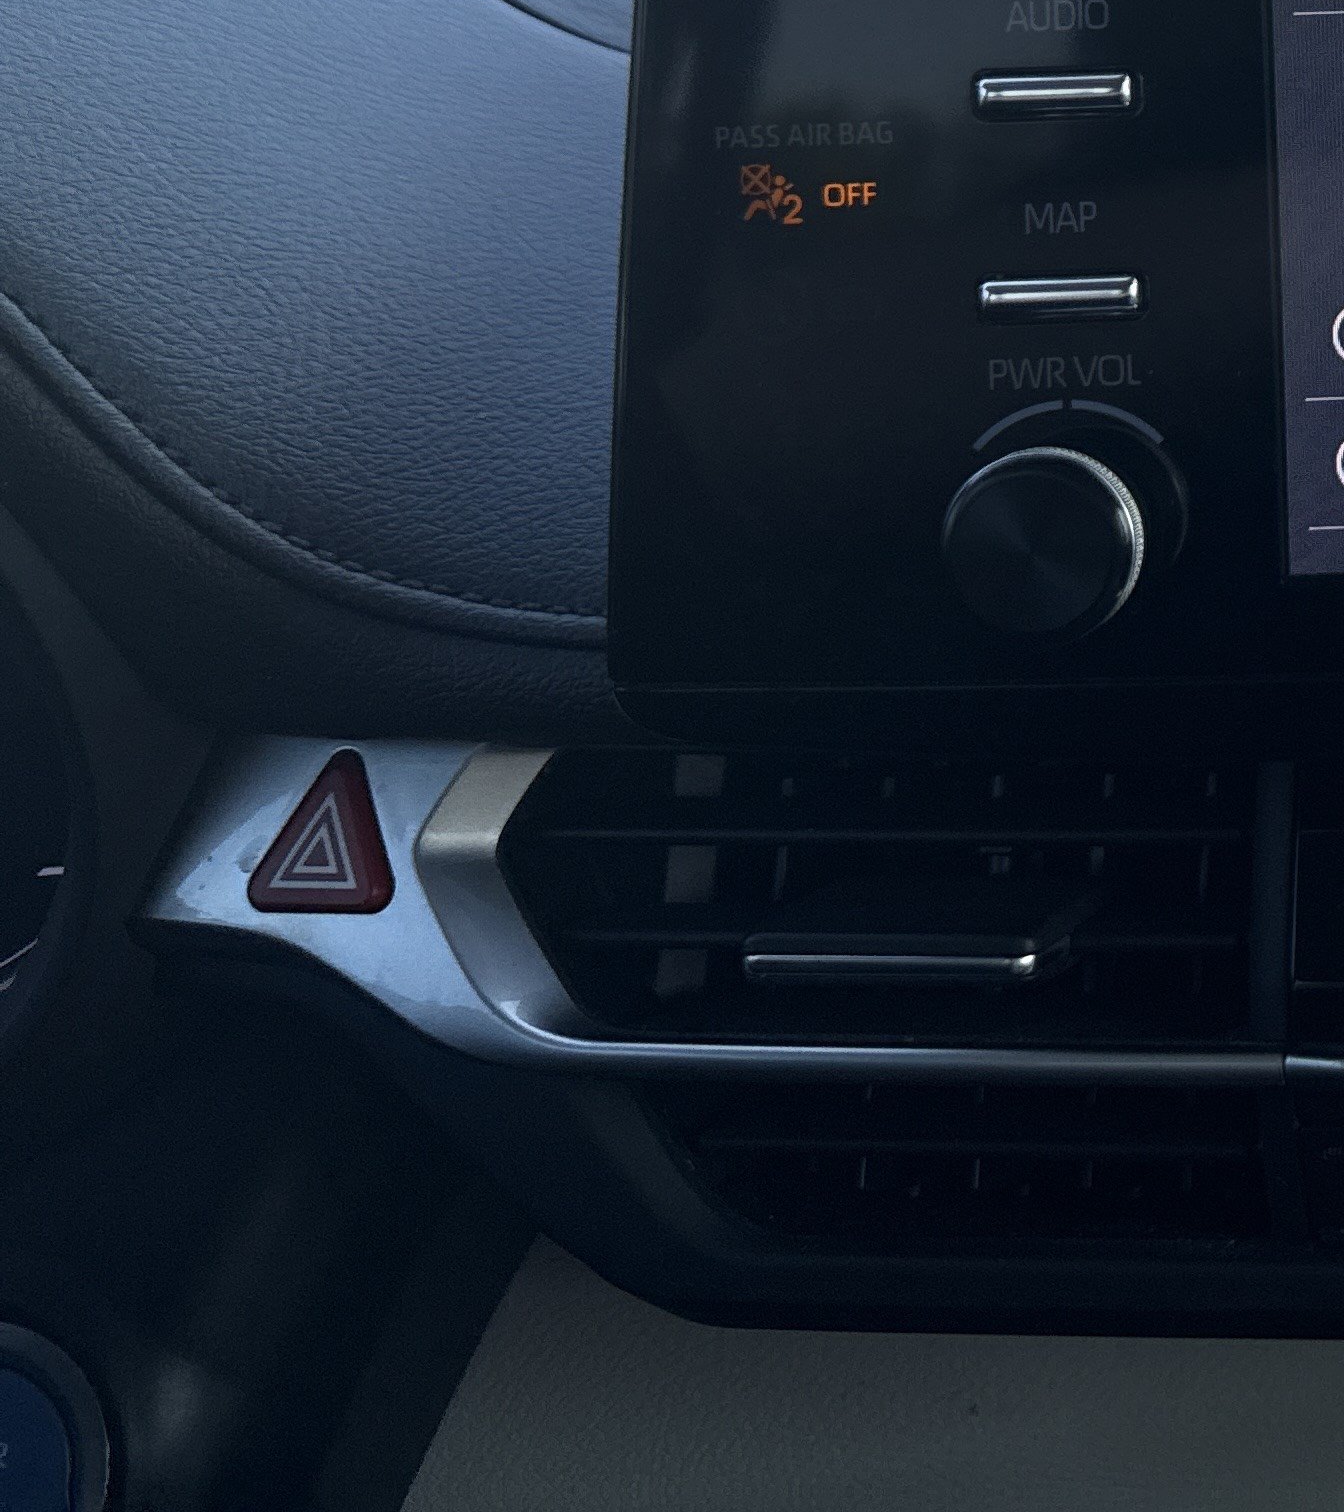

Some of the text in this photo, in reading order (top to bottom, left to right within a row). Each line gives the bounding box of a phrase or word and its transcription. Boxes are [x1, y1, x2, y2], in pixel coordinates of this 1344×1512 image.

[714, 120, 894, 148] PASS AIR BAG
[822, 182, 878, 207] OFF
[1024, 201, 1098, 234] MAP
[988, 355, 1142, 390] PWR VOL
